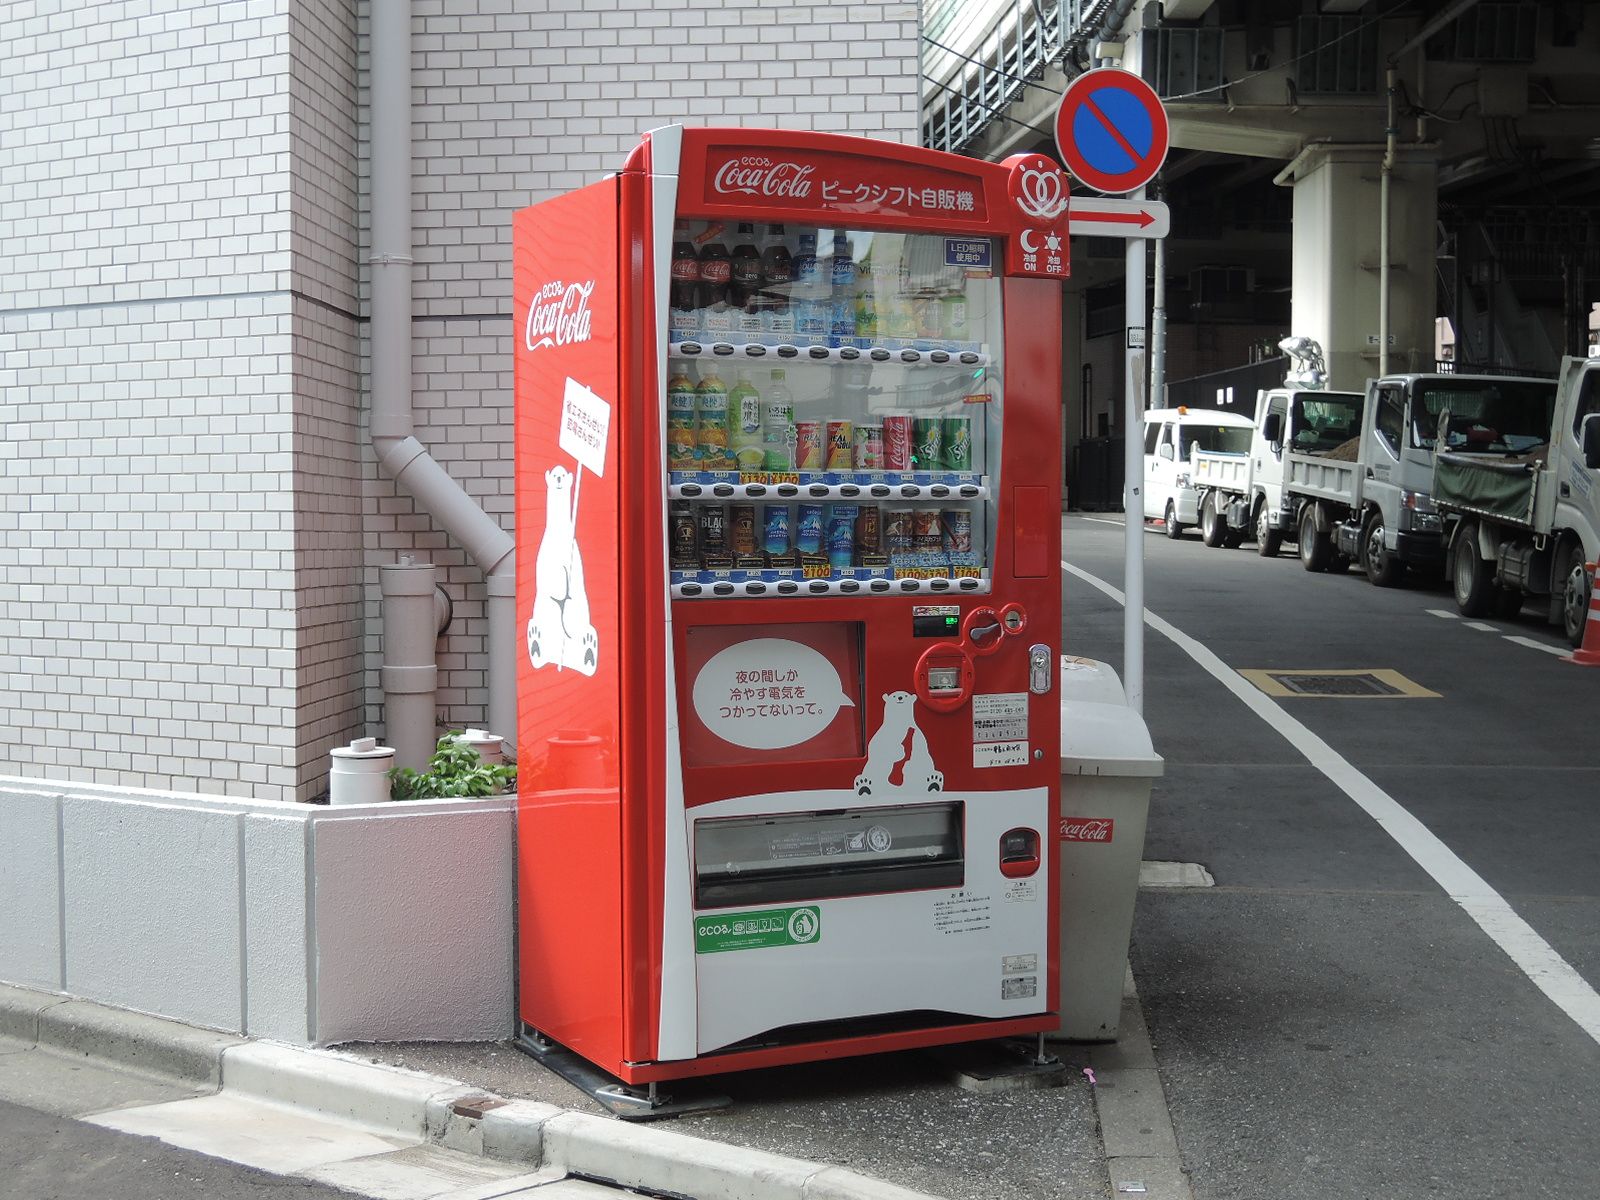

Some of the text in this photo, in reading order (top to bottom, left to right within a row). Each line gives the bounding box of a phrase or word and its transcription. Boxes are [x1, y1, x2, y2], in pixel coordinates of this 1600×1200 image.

[714, 159, 816, 199] Coca-Cola
[822, 180, 975, 211] ピークシフト自販機
[956, 252, 981, 263] 使用中
[1024, 263, 1037, 272] ON
[1046, 265, 1061, 273] OFF
[525, 279, 595, 351] Coca-Cola
[890, 421, 904, 467] Coca-Cola
[740, 474, 768, 485] ¥130
[770, 475, 799, 485] ¥100
[804, 567, 830, 578] ¥100
[895, 570, 921, 579] ¥100
[954, 569, 979, 579] ¥100
[735, 669, 798, 684] 夜の間しか
[729, 686, 805, 702] 冷やす電気を
[719, 703, 824, 719] つかってないって。
[1060, 819, 1111, 842] oca-Cola
